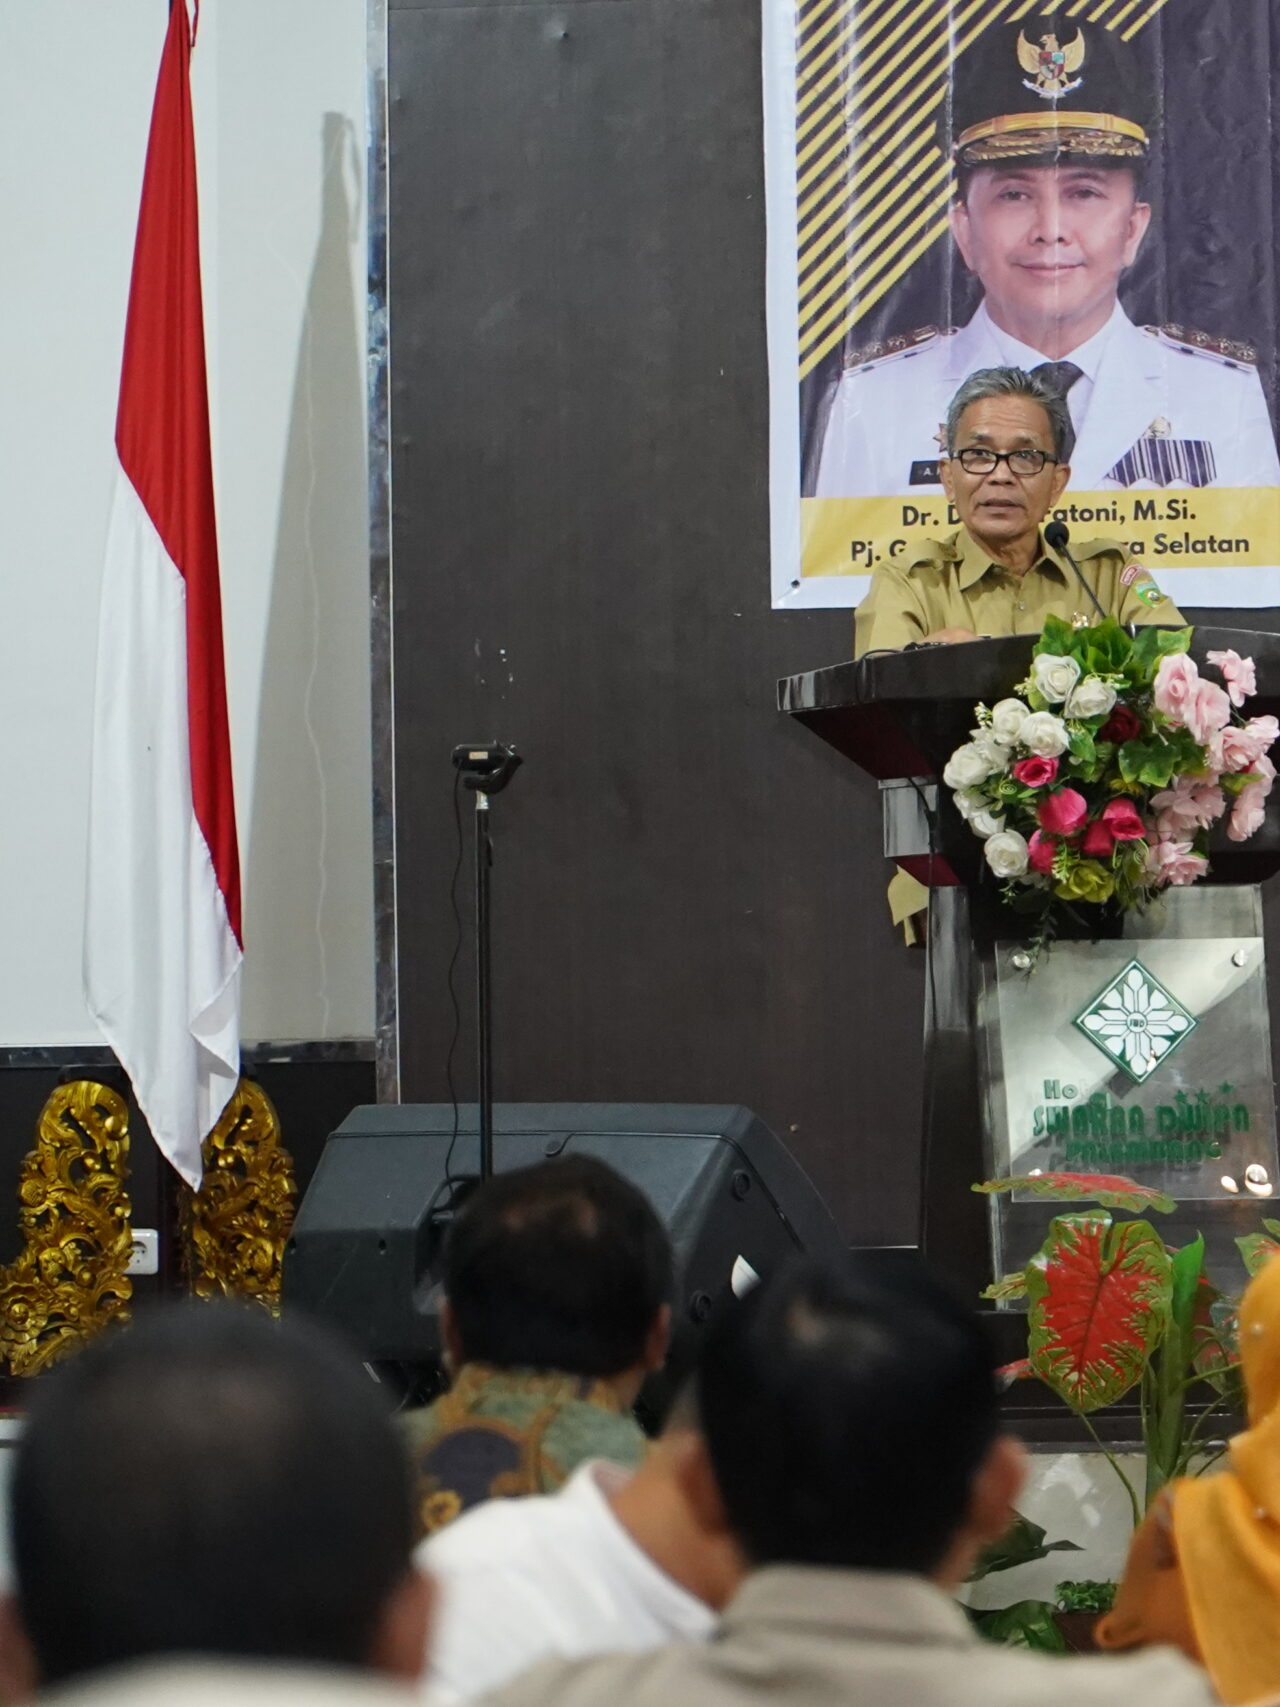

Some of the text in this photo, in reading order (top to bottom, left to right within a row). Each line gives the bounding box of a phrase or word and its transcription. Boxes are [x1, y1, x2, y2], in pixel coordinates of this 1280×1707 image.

[903, 505, 939, 526] Dr.
[1133, 499, 1196, 521] M.Si.
[851, 540, 881, 568] Pj.
[1153, 532, 1250, 555] Selatan
